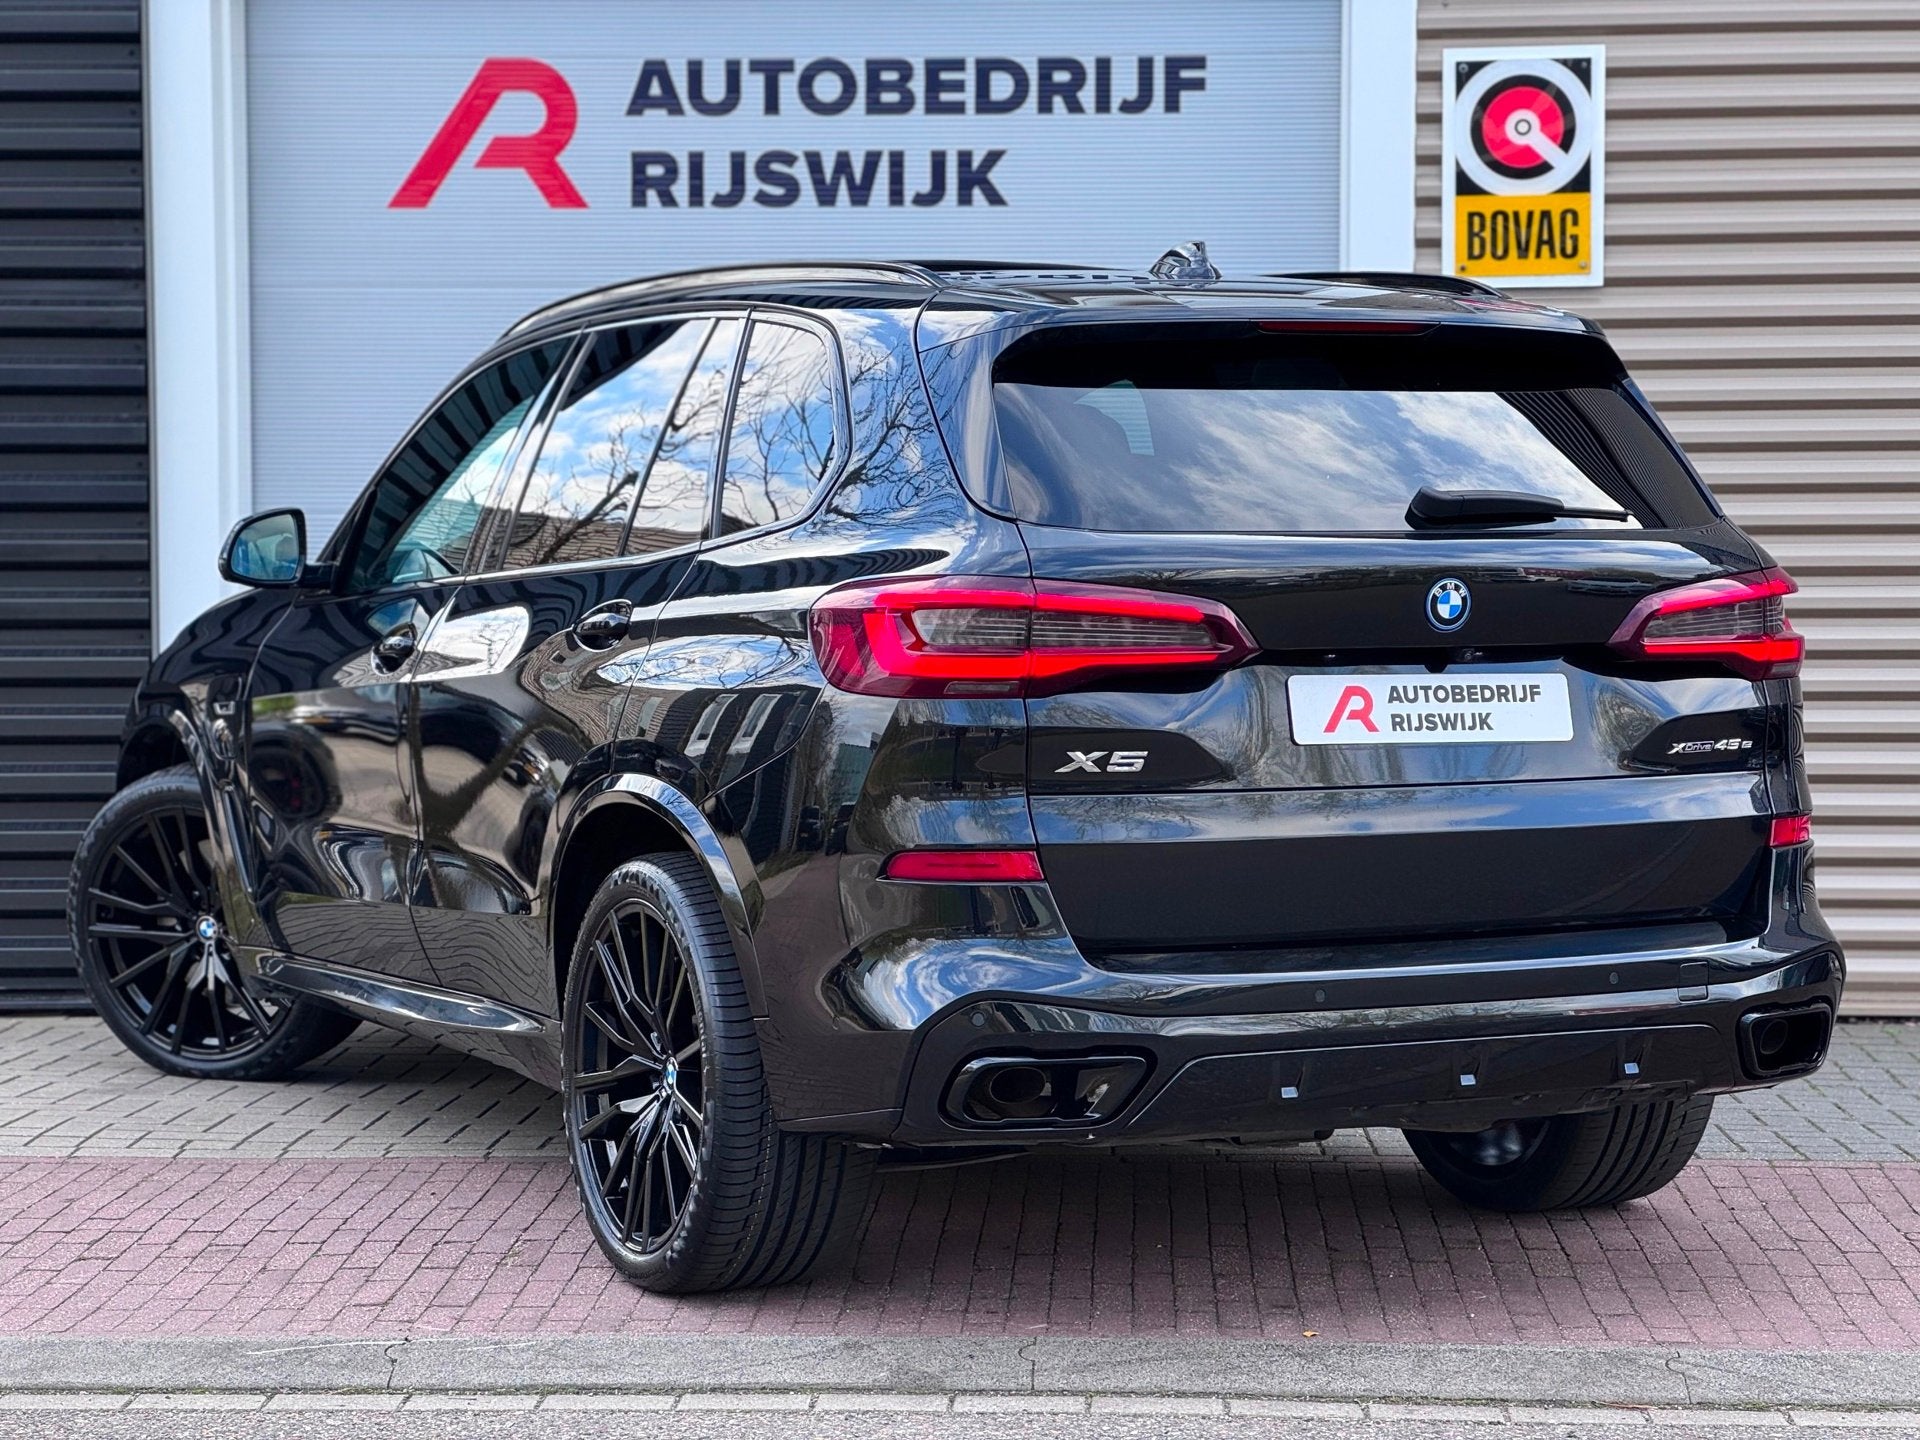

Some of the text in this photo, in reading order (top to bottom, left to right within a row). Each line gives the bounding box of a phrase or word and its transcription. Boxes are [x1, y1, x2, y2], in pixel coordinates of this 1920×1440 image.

[626, 55, 1207, 117] AUTOBEDRIJF
[631, 149, 1009, 209] RIJSWIJK
[1466, 207, 1580, 262] BOVAG
[1434, 582, 1467, 597] BMW
[1387, 684, 1542, 704] AUTOBEDRIJF
[1390, 712, 1494, 732] RIJSWIJK
[1054, 751, 1149, 773] X5
